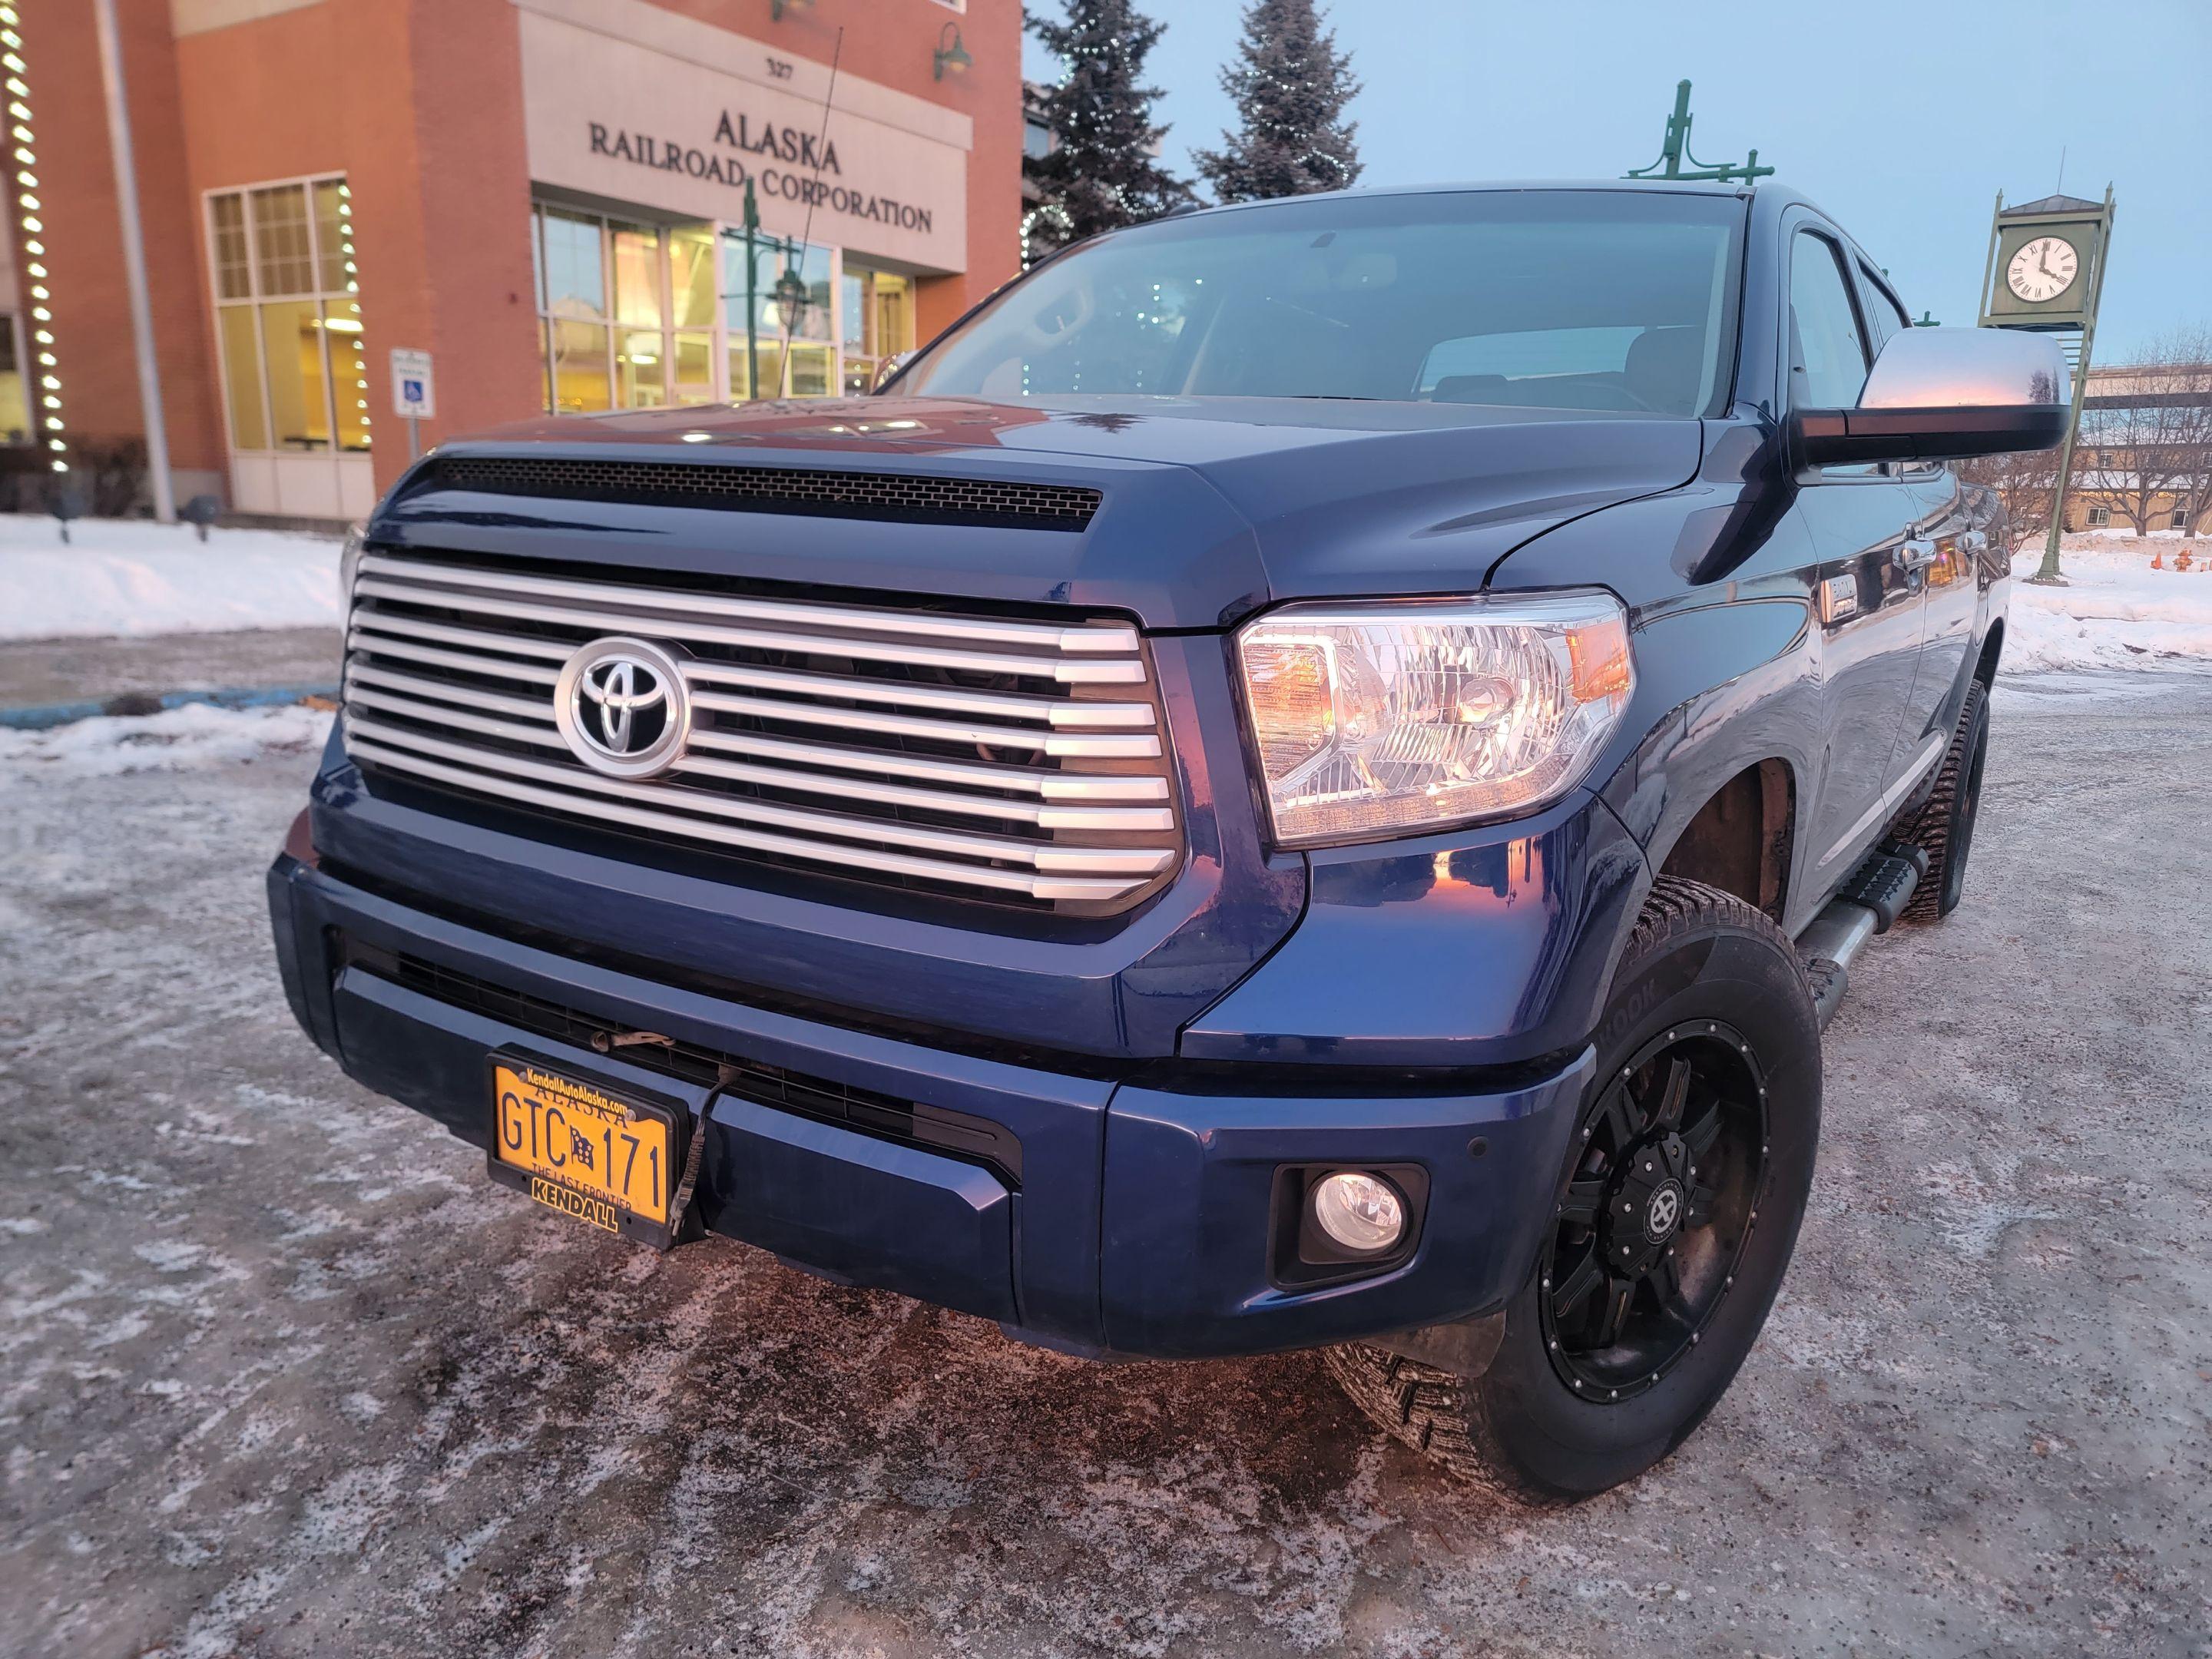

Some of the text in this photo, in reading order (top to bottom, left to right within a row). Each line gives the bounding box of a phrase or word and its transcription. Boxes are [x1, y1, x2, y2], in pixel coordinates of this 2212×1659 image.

[765, 56, 793, 80] 327
[714, 108, 842, 175] ALASKA
[588, 121, 932, 233] RAILROAD CORPORATION
[527, 1068, 628, 1114] KendallAutoAlaska.com
[502, 1091, 659, 1208] GTC 171
[531, 1162, 551, 1180] THE
[554, 1171, 579, 1190] LAST
[531, 1177, 618, 1233] KENDALL
